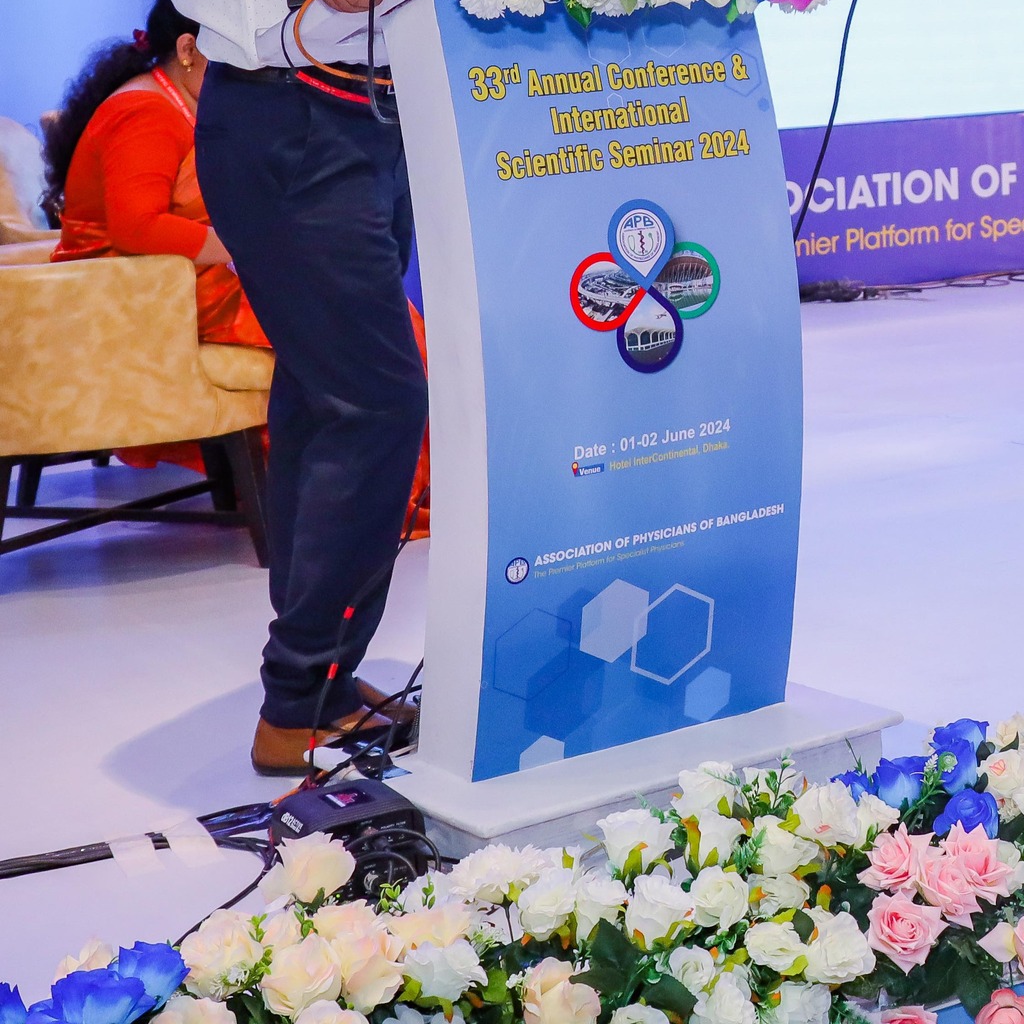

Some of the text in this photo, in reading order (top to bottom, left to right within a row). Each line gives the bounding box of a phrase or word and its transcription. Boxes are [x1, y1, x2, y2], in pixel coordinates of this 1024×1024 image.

[468, 53, 750, 102] 33rd Annual Conference &
[550, 96, 690, 134] International
[496, 129, 750, 181] Scientific Seminar 2024
[971, 162, 1016, 199] OF
[624, 215, 654, 229] APB
[846, 224, 939, 252] Platform
[945, 218, 974, 243] for
[574, 444, 607, 461] Date
[620, 432, 658, 452] 01-02
[662, 426, 695, 445] June
[699, 418, 731, 437] 2024
[578, 465, 601, 476] Venue
[609, 459, 631, 471] Hotel
[534, 503, 785, 567] ASSOCIATION OF PHYSICIANS OF BANGLADESH
